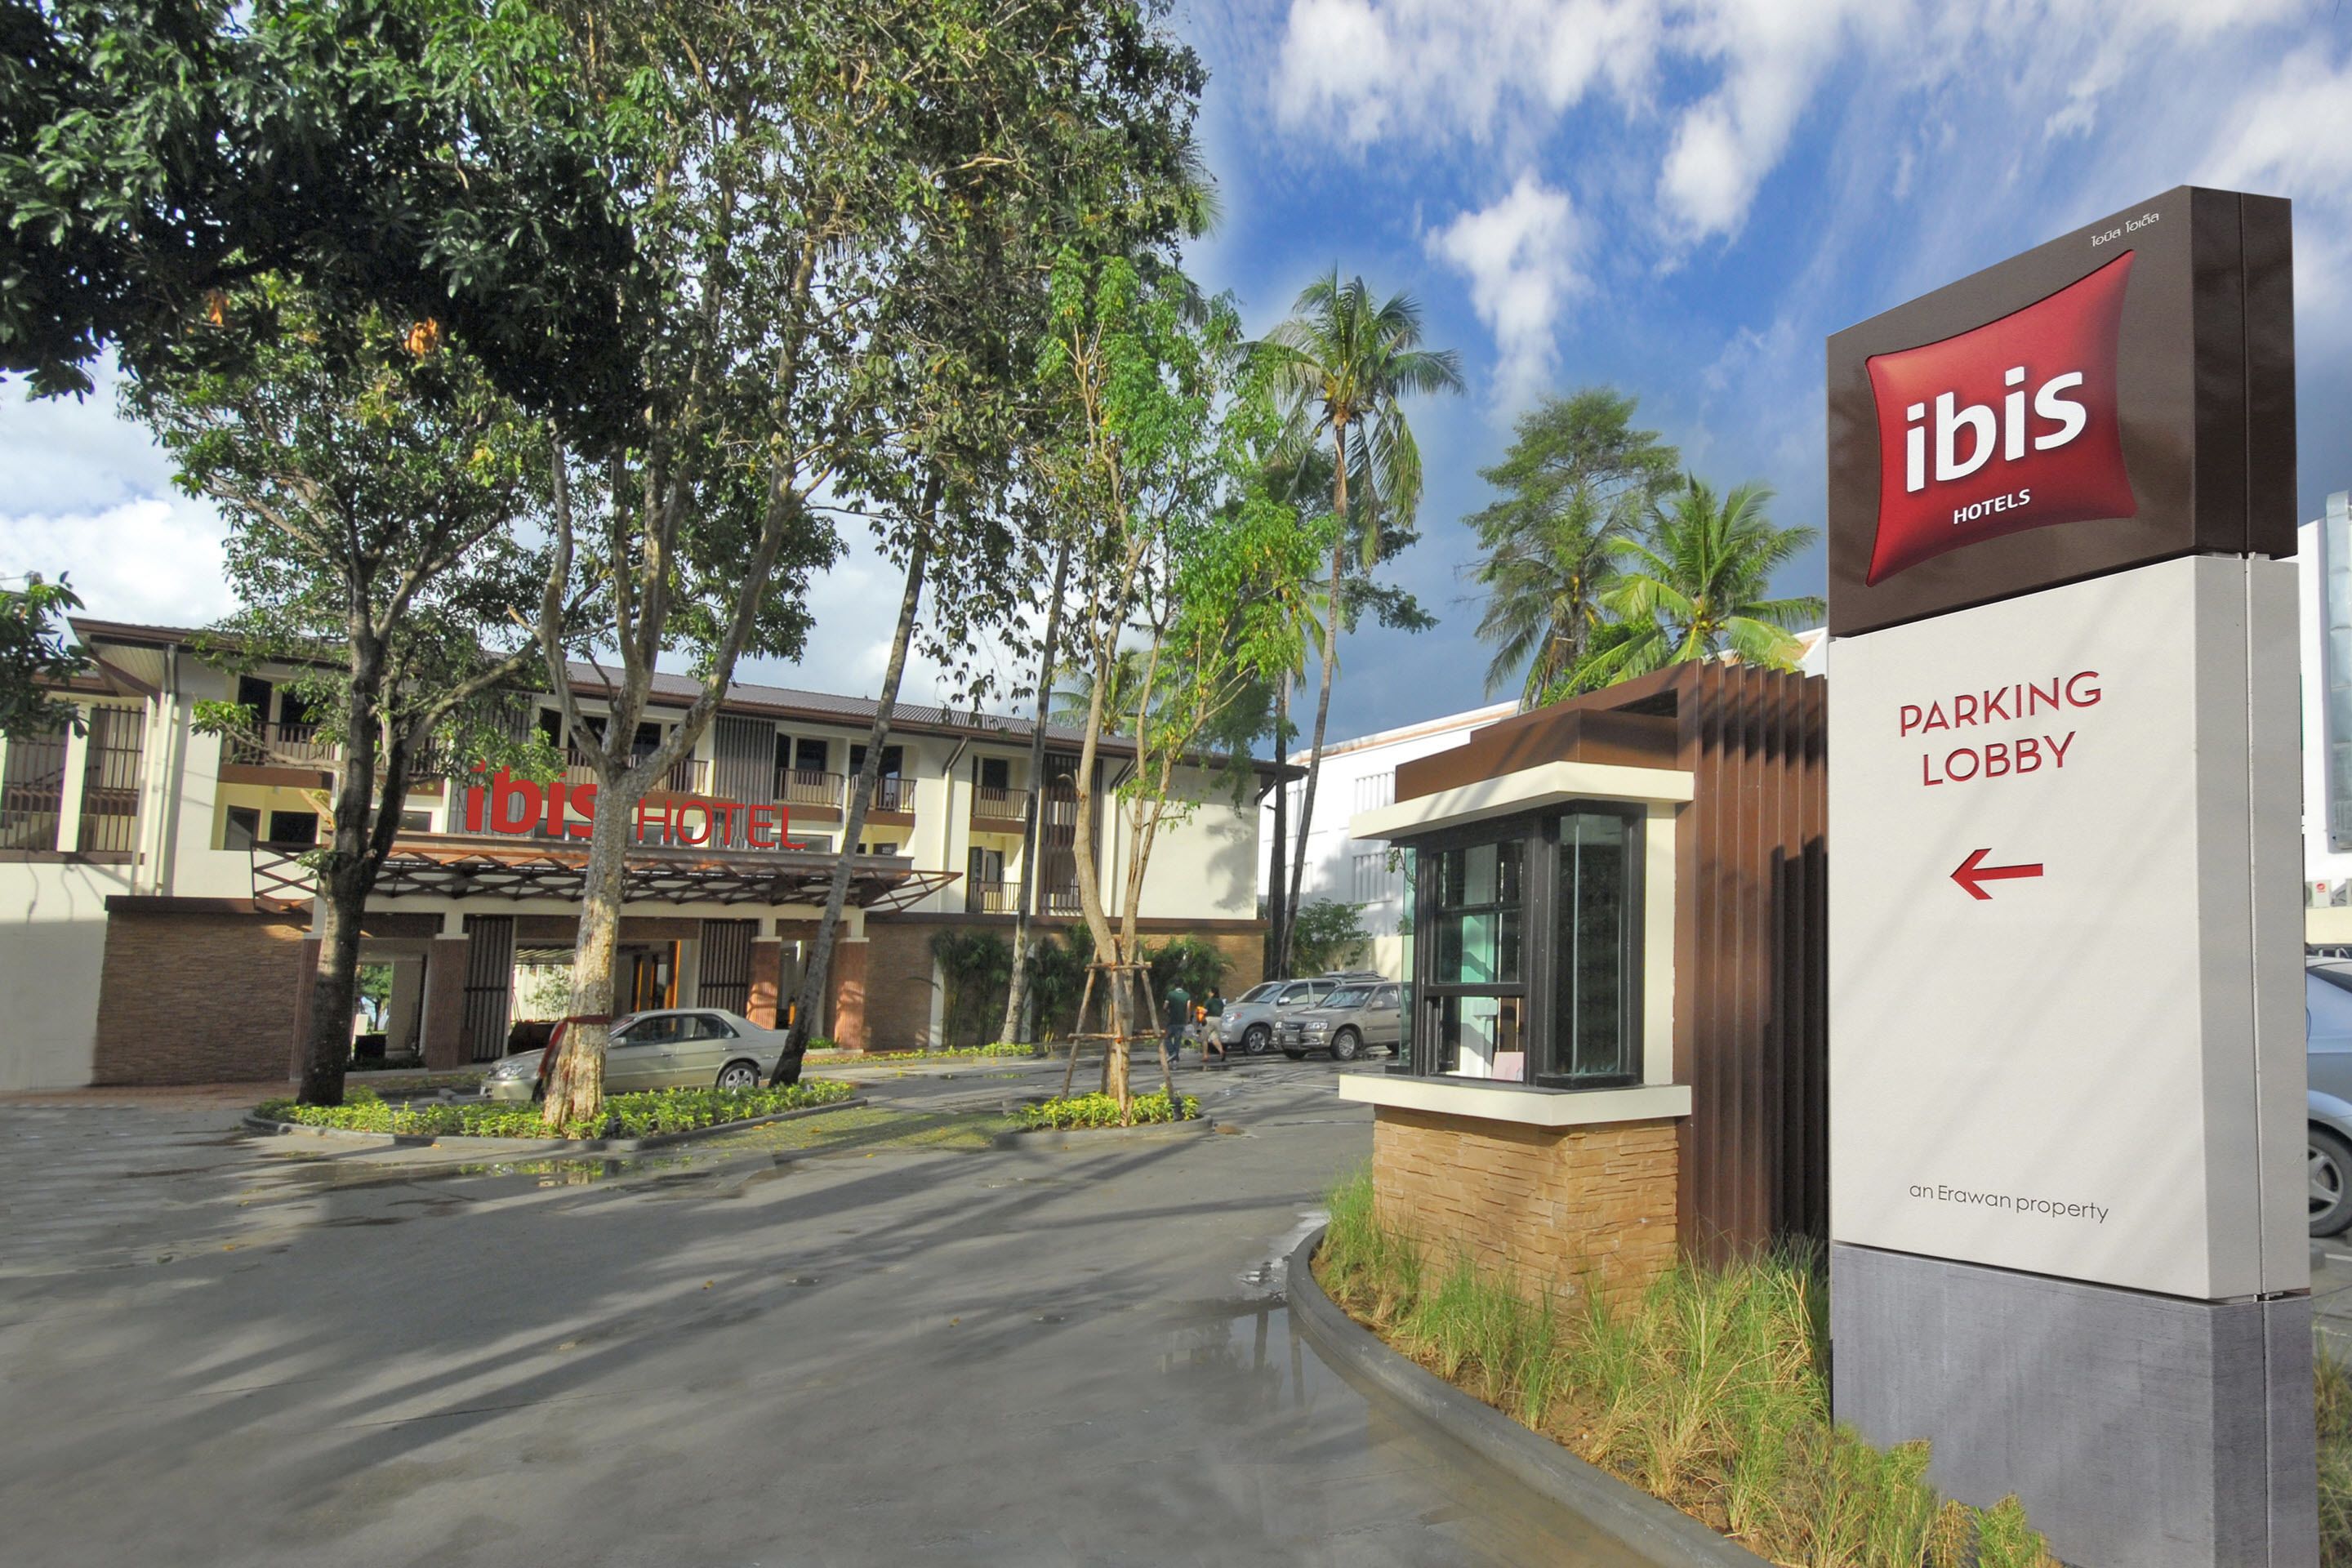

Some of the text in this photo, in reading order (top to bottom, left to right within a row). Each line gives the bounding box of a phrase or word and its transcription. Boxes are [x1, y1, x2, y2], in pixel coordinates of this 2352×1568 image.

[1906, 366, 2087, 493] ibis
[1953, 488, 2032, 524] HOTELS
[1900, 670, 2103, 738] PARKING
[1922, 730, 2076, 787] LOBBY
[636, 797, 808, 850] HOTEL
[1909, 1183, 2109, 1224] an Erawan property
